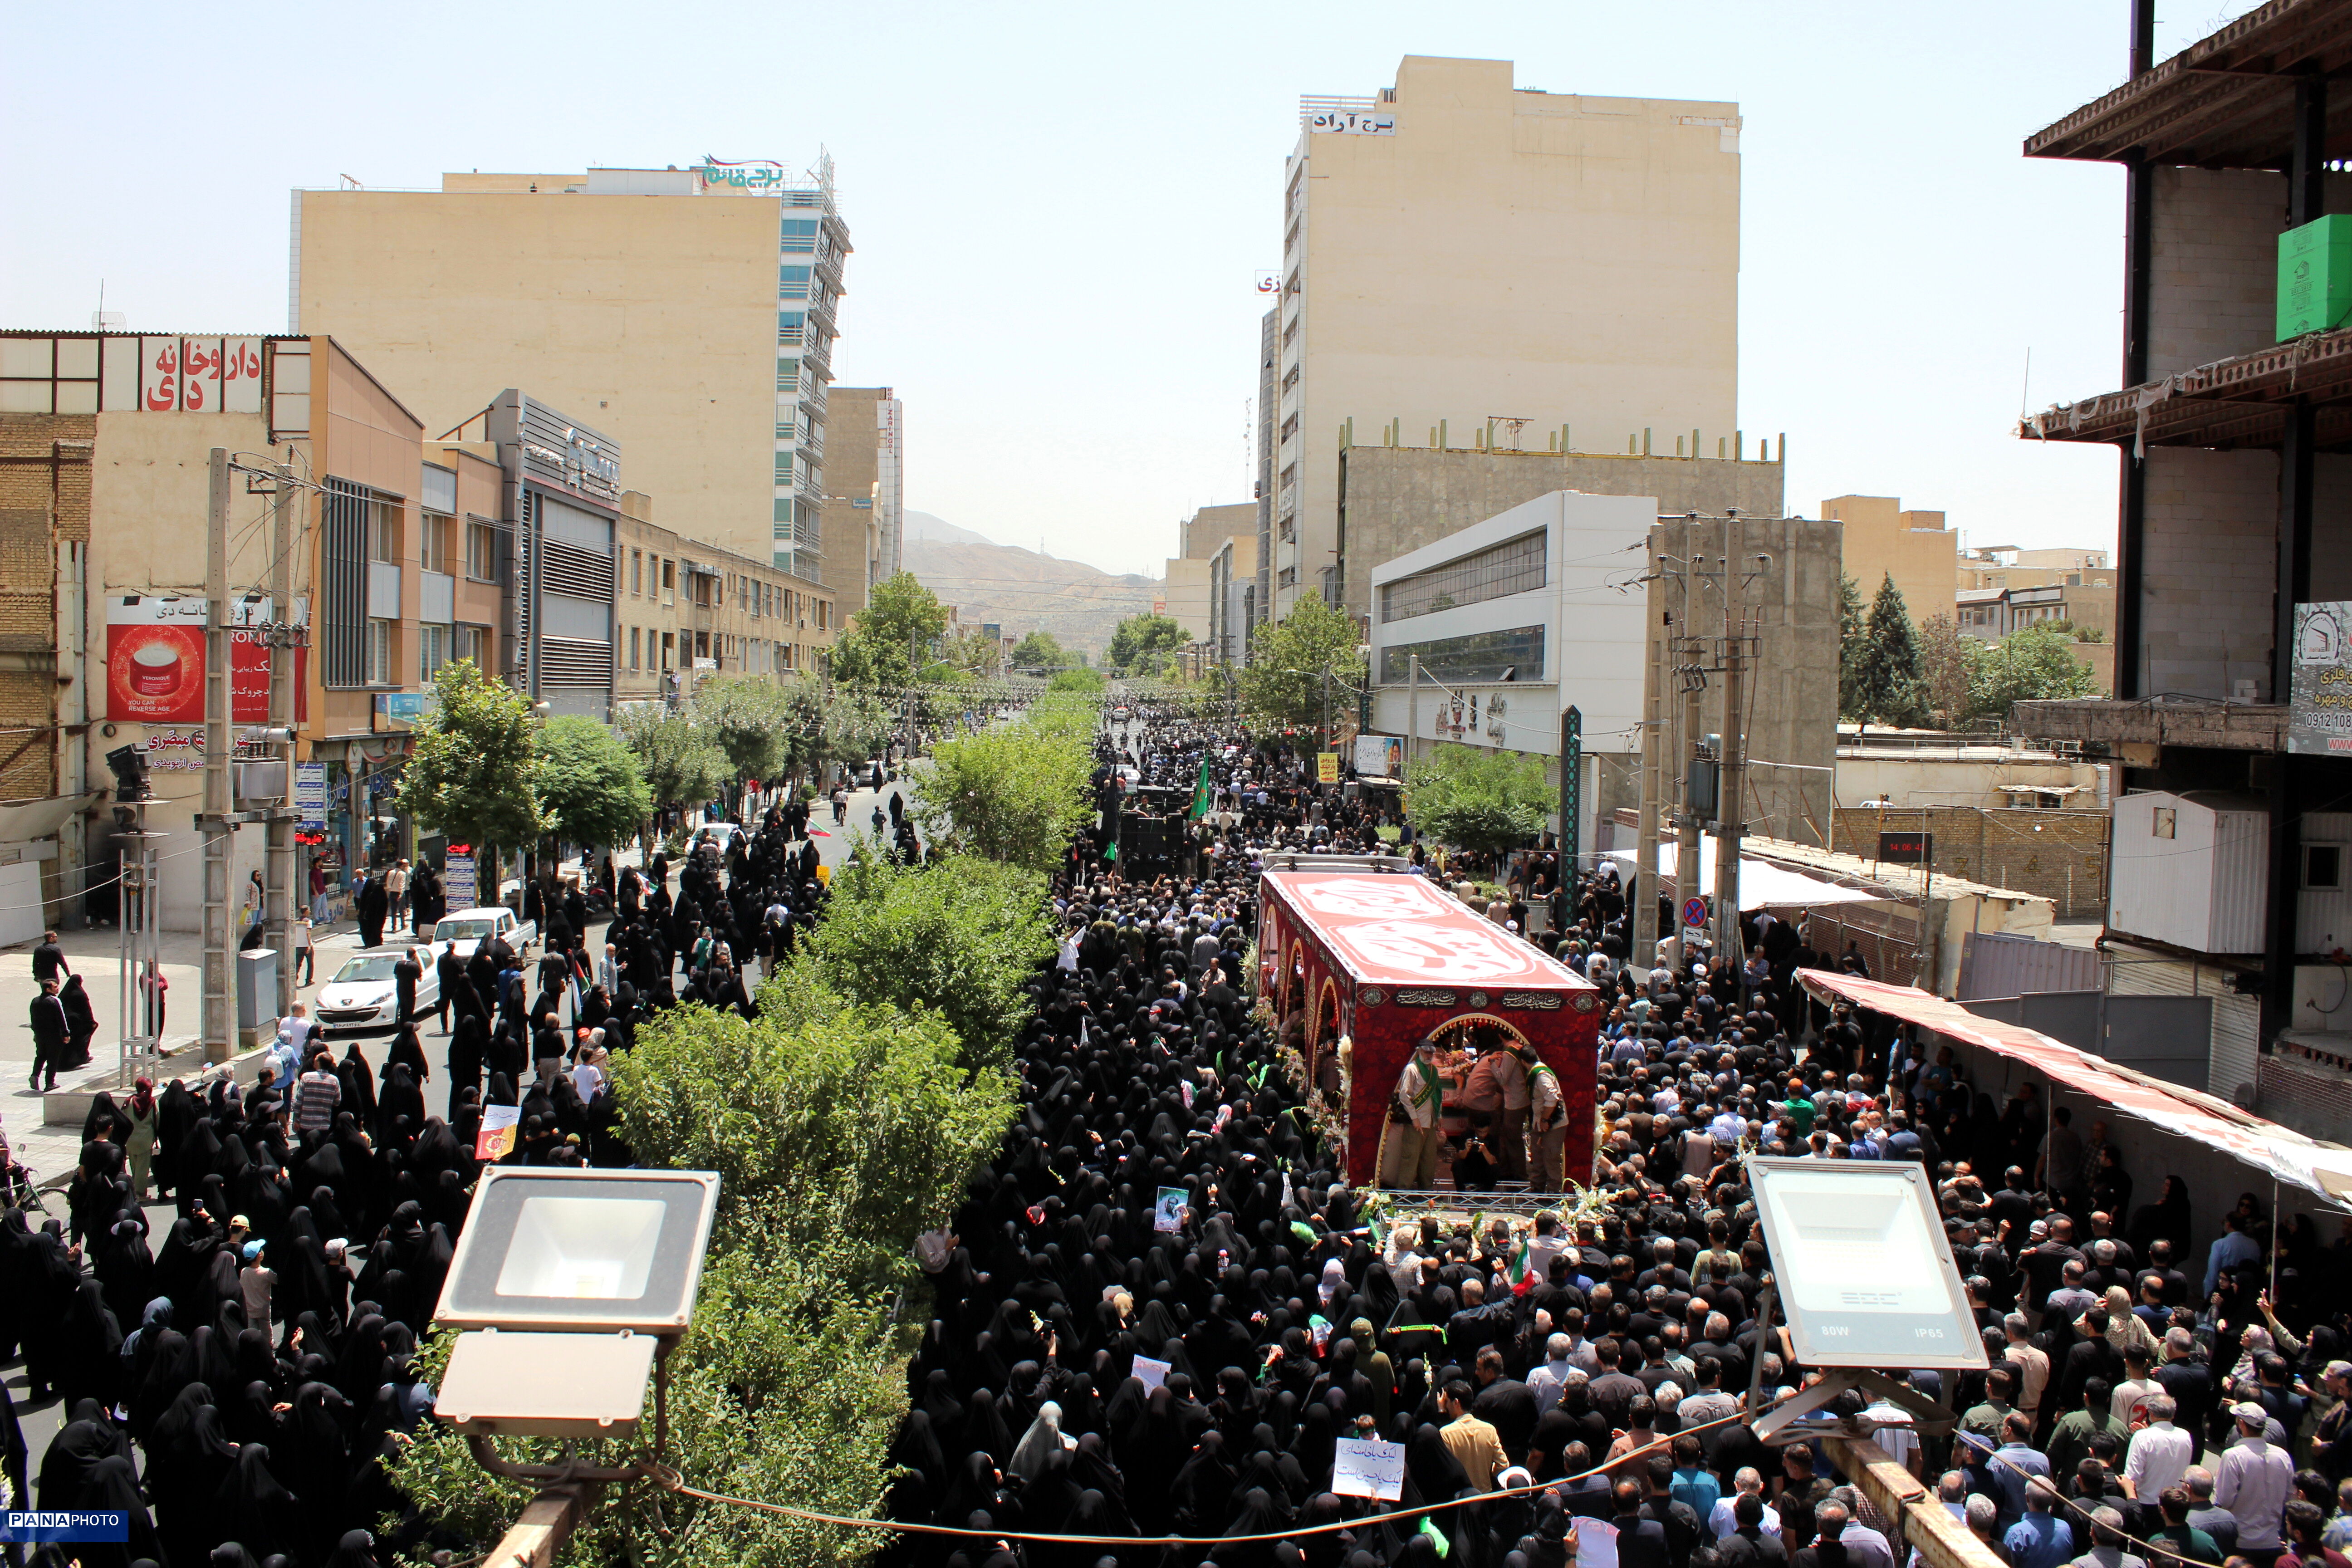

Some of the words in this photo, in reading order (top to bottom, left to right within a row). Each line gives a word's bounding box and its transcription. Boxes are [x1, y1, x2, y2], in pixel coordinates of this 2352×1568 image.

[1314, 113, 1359, 132] آراد
[1362, 120, 1393, 132] برج
[747, 169, 783, 188] برج
[156, 341, 260, 380] داروخانه
[147, 375, 203, 411] دی
[157, 606, 174, 619] دی
[2320, 665, 2345, 685] فلزی
[2314, 694, 2338, 708] مهره
[2307, 714, 2331, 727] 0912
[2023, 855, 2041, 877] 4
[2085, 855, 2101, 879] 5
[1822, 1325, 1849, 1336] 80W
[1914, 1328, 1944, 1339] IP65
[1372, 1444, 1377, 1461] یا
[1377, 1445, 1396, 1462] لبیک
[1356, 1470, 1378, 1482] حسین
[1377, 1469, 1382, 1484] یا
[1382, 1469, 1402, 1488] لبیک
